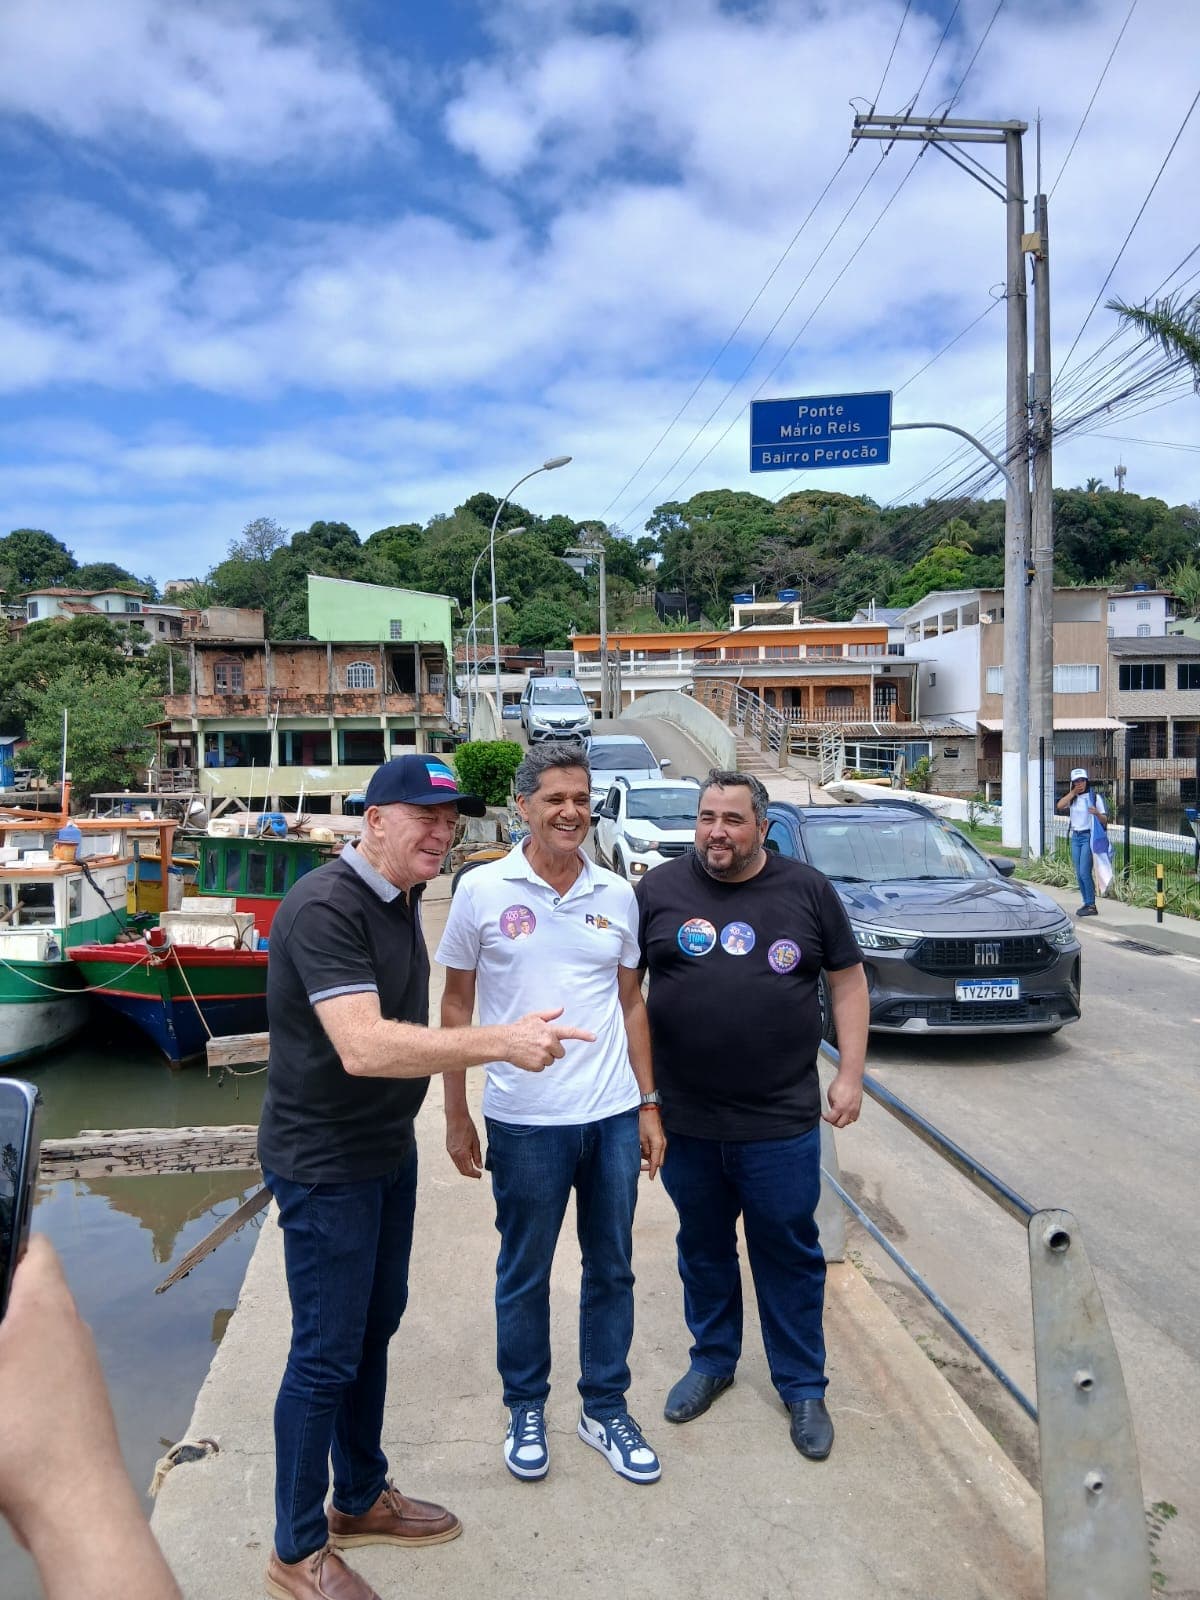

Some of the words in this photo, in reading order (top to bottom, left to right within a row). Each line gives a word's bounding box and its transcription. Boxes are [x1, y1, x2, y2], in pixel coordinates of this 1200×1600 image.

[798, 404, 844, 418] Ponte
[780, 422, 822, 437] Mário
[827, 420, 861, 434] Reis
[762, 451, 809, 464] Bairro
[814, 445, 878, 461] Perocão
[776, 947, 795, 964] 15
[974, 943, 1001, 965] FIAT
[961, 986, 1013, 999] TYZ7F70
